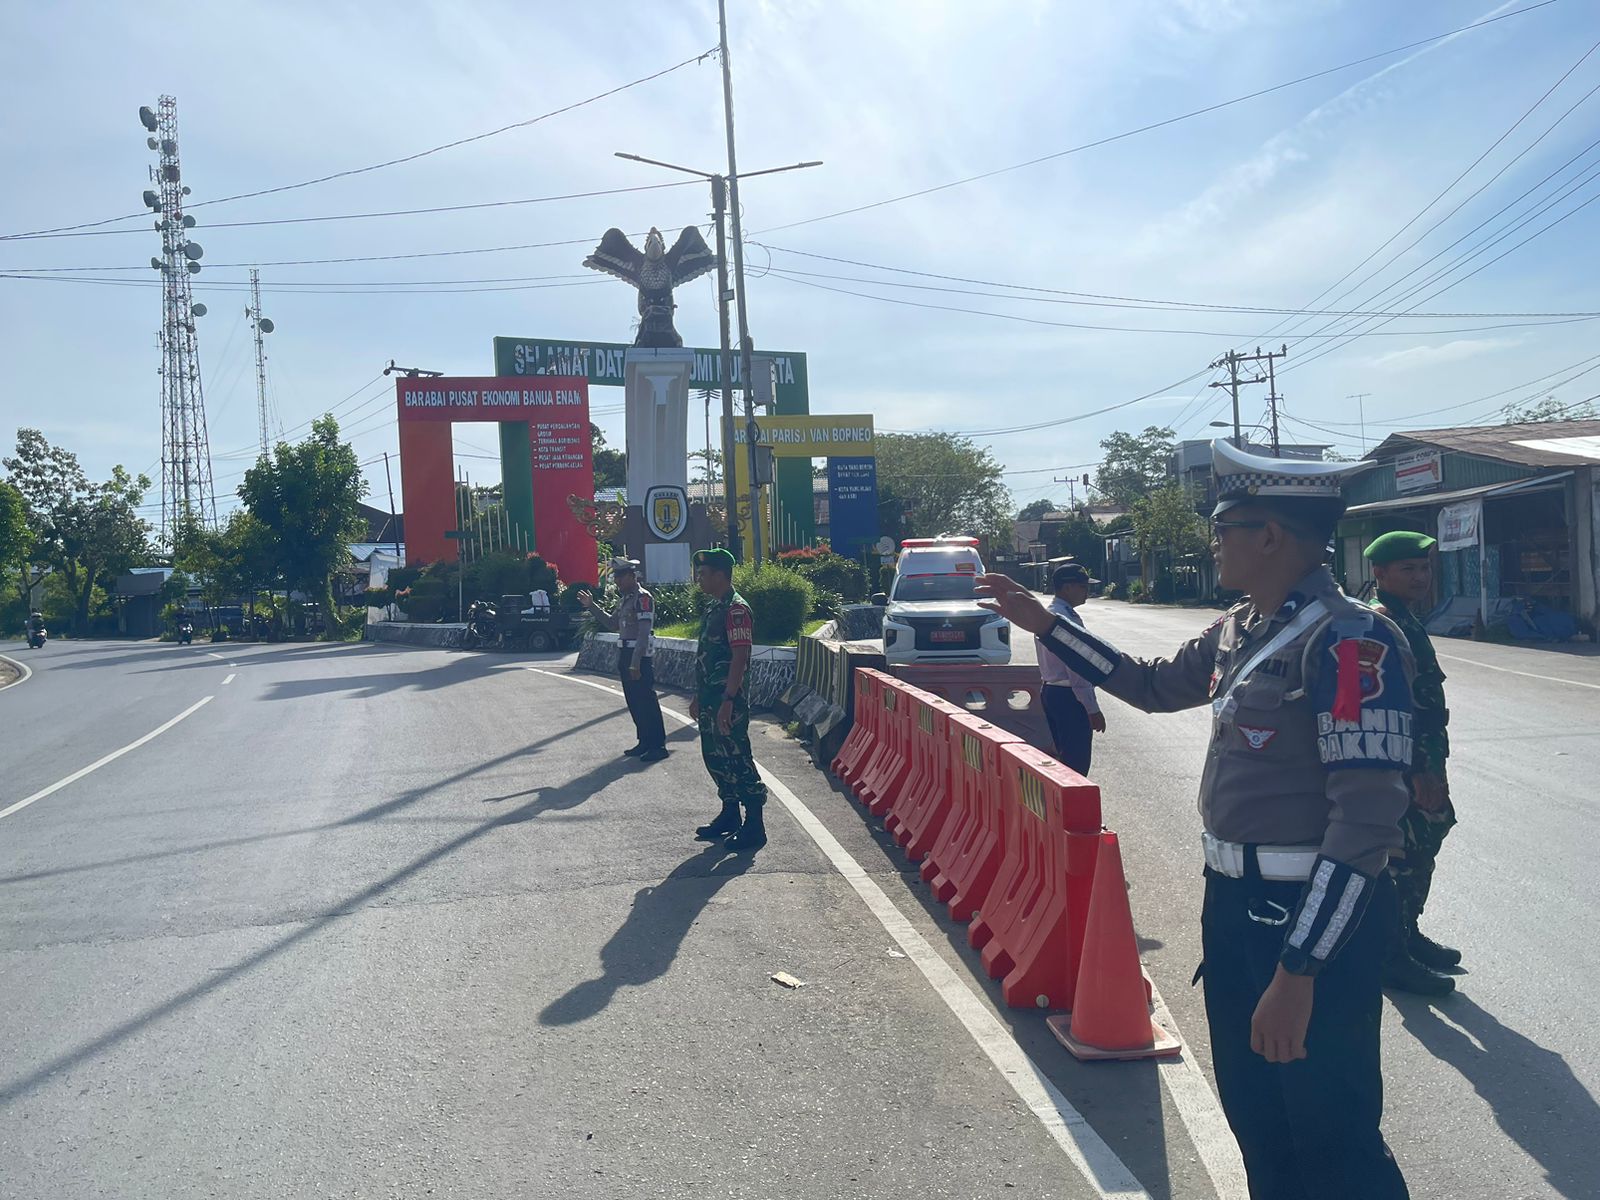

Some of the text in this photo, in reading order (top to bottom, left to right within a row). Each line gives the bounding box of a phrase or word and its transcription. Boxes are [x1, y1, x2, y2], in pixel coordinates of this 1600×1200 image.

[514, 344, 590, 376] SELAMAT
[405, 390, 582, 406] BARABAI PUSAT EKONOMI BANUA ENAM
[810, 428, 830, 443] VAN
[832, 428, 871, 443] BORNEO
